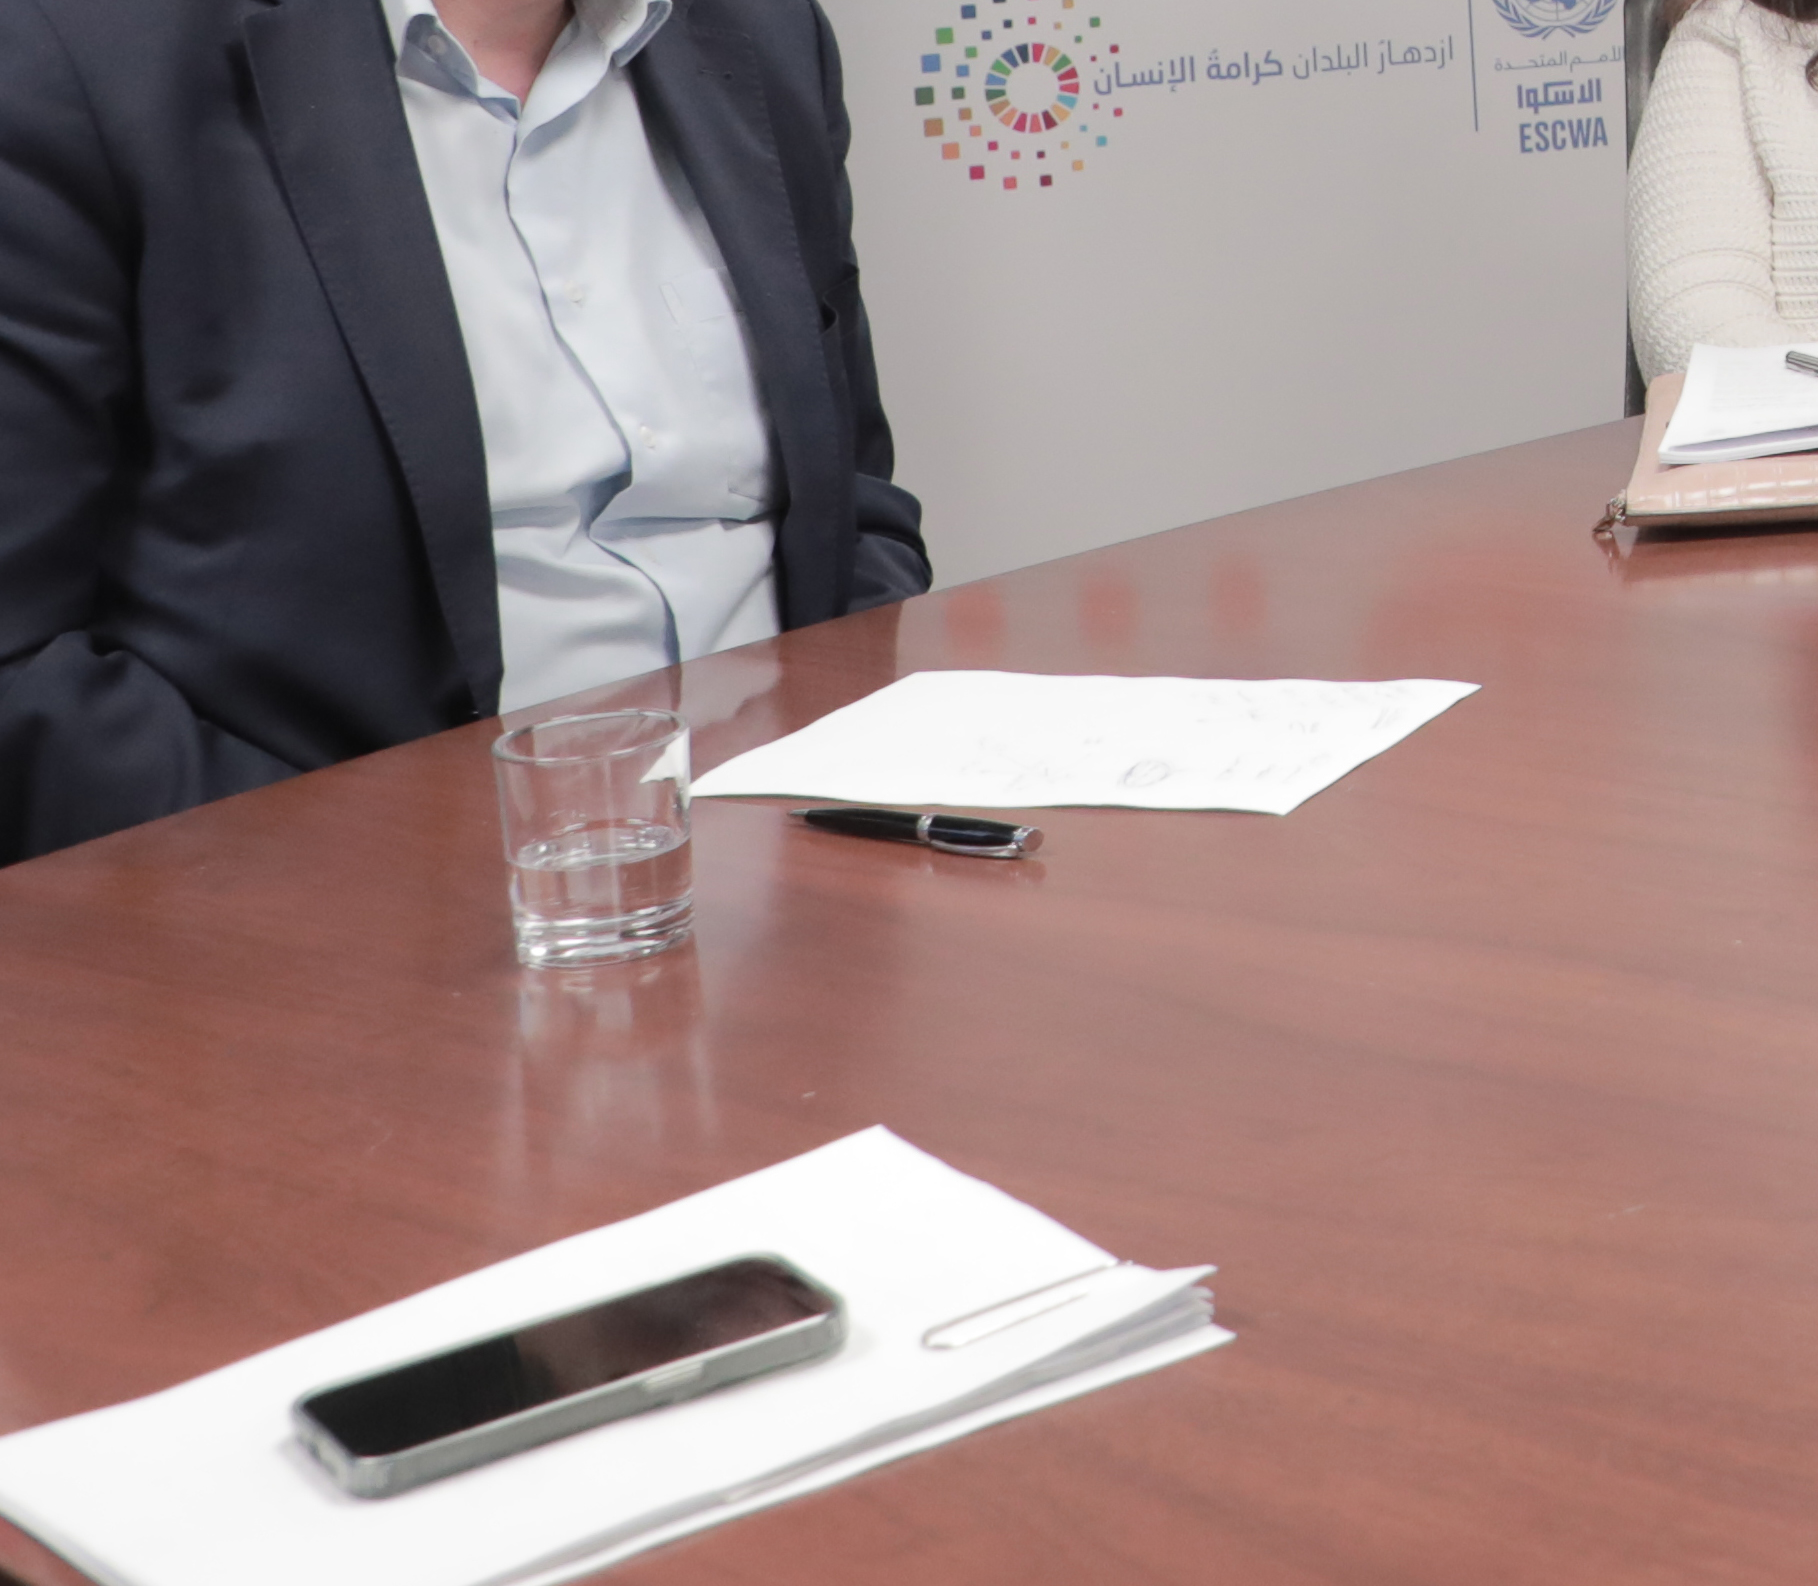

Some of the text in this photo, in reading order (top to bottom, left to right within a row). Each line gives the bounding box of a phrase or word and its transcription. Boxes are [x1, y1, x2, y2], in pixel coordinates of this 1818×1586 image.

[1092, 52, 1195, 95] الإنسان
[1293, 42, 1368, 79] البلدان
[1494, 51, 1567, 71] المتحدة
[1519, 117, 1608, 153] ESCWA
